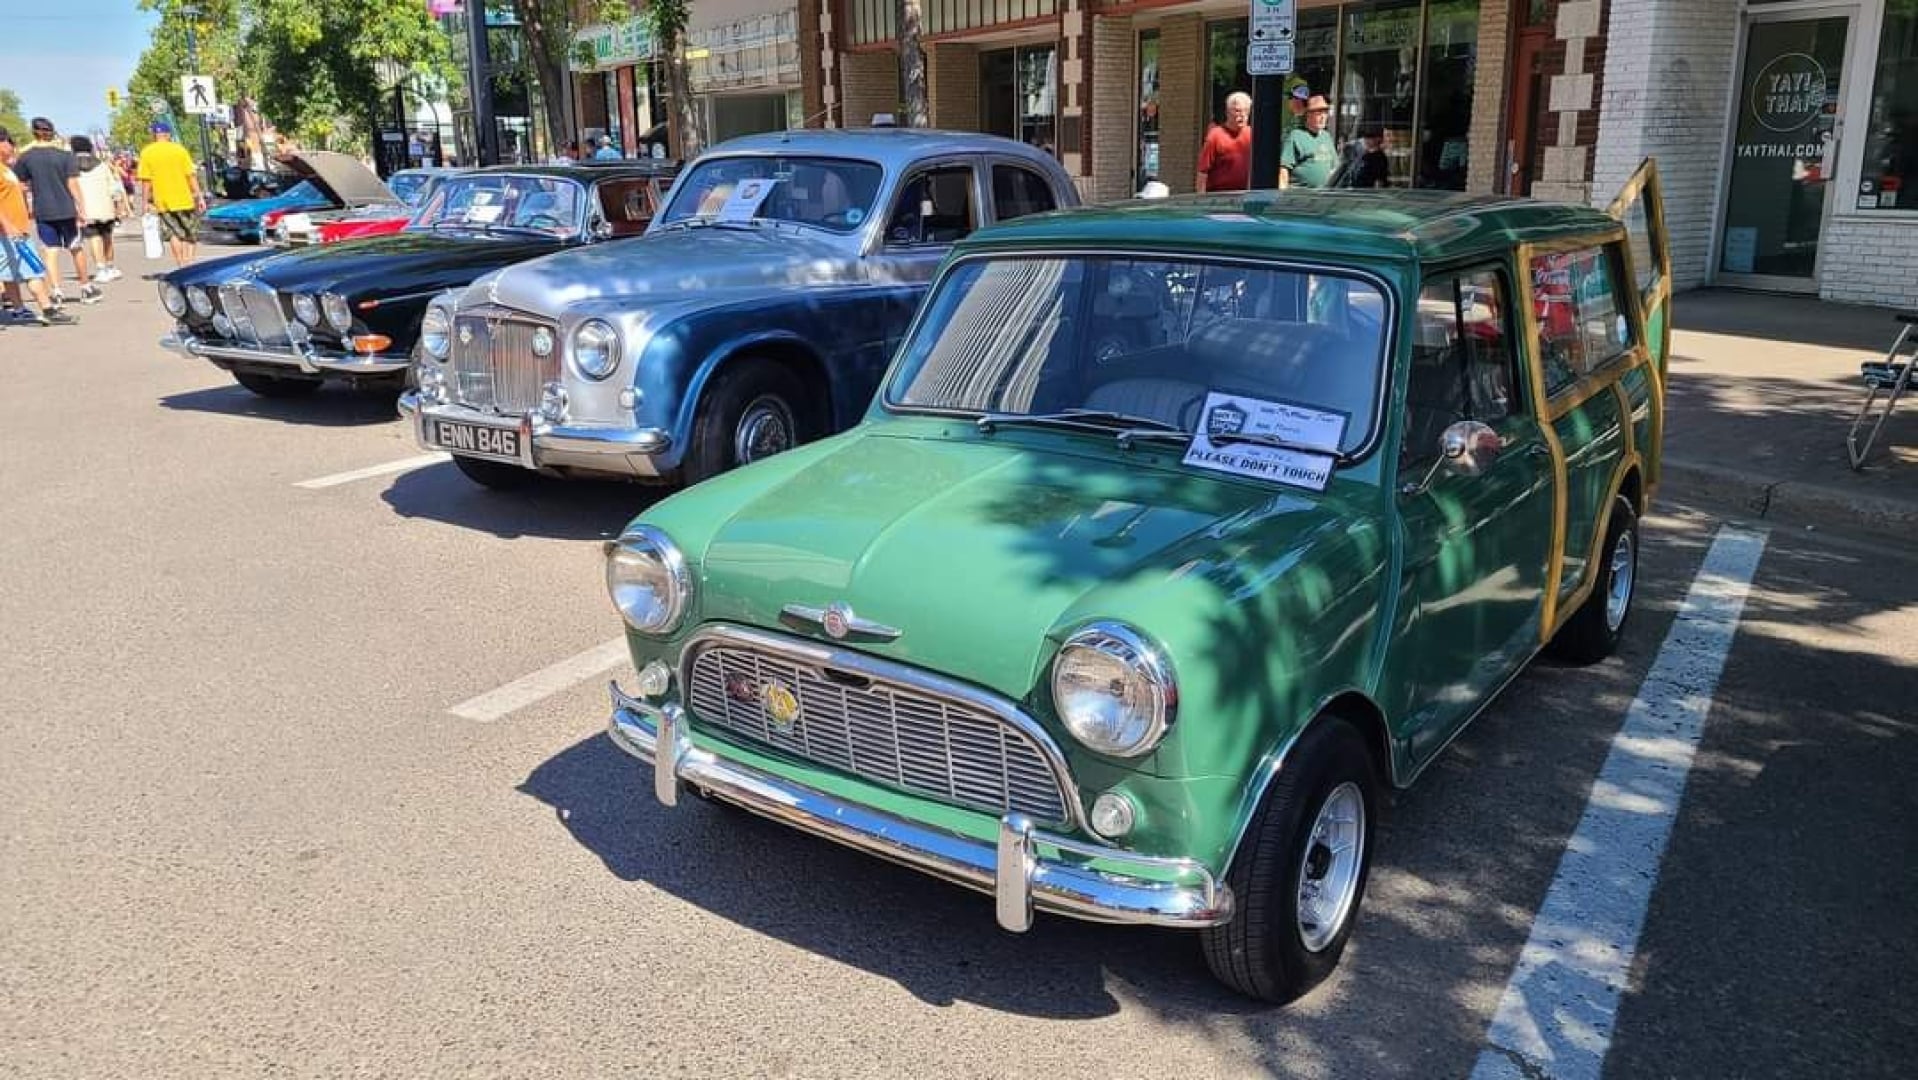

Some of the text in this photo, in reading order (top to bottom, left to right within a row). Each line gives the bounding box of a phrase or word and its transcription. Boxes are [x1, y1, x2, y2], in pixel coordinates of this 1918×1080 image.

[1766, 95, 1810, 114] THAI
[1737, 143, 1825, 157] YAYTHAI.COM
[440, 422, 516, 455] ENN 846
[1189, 449, 1235, 466] PLEASE
[1240, 458, 1280, 472] DON'T
[1283, 464, 1326, 482] TOUCH
